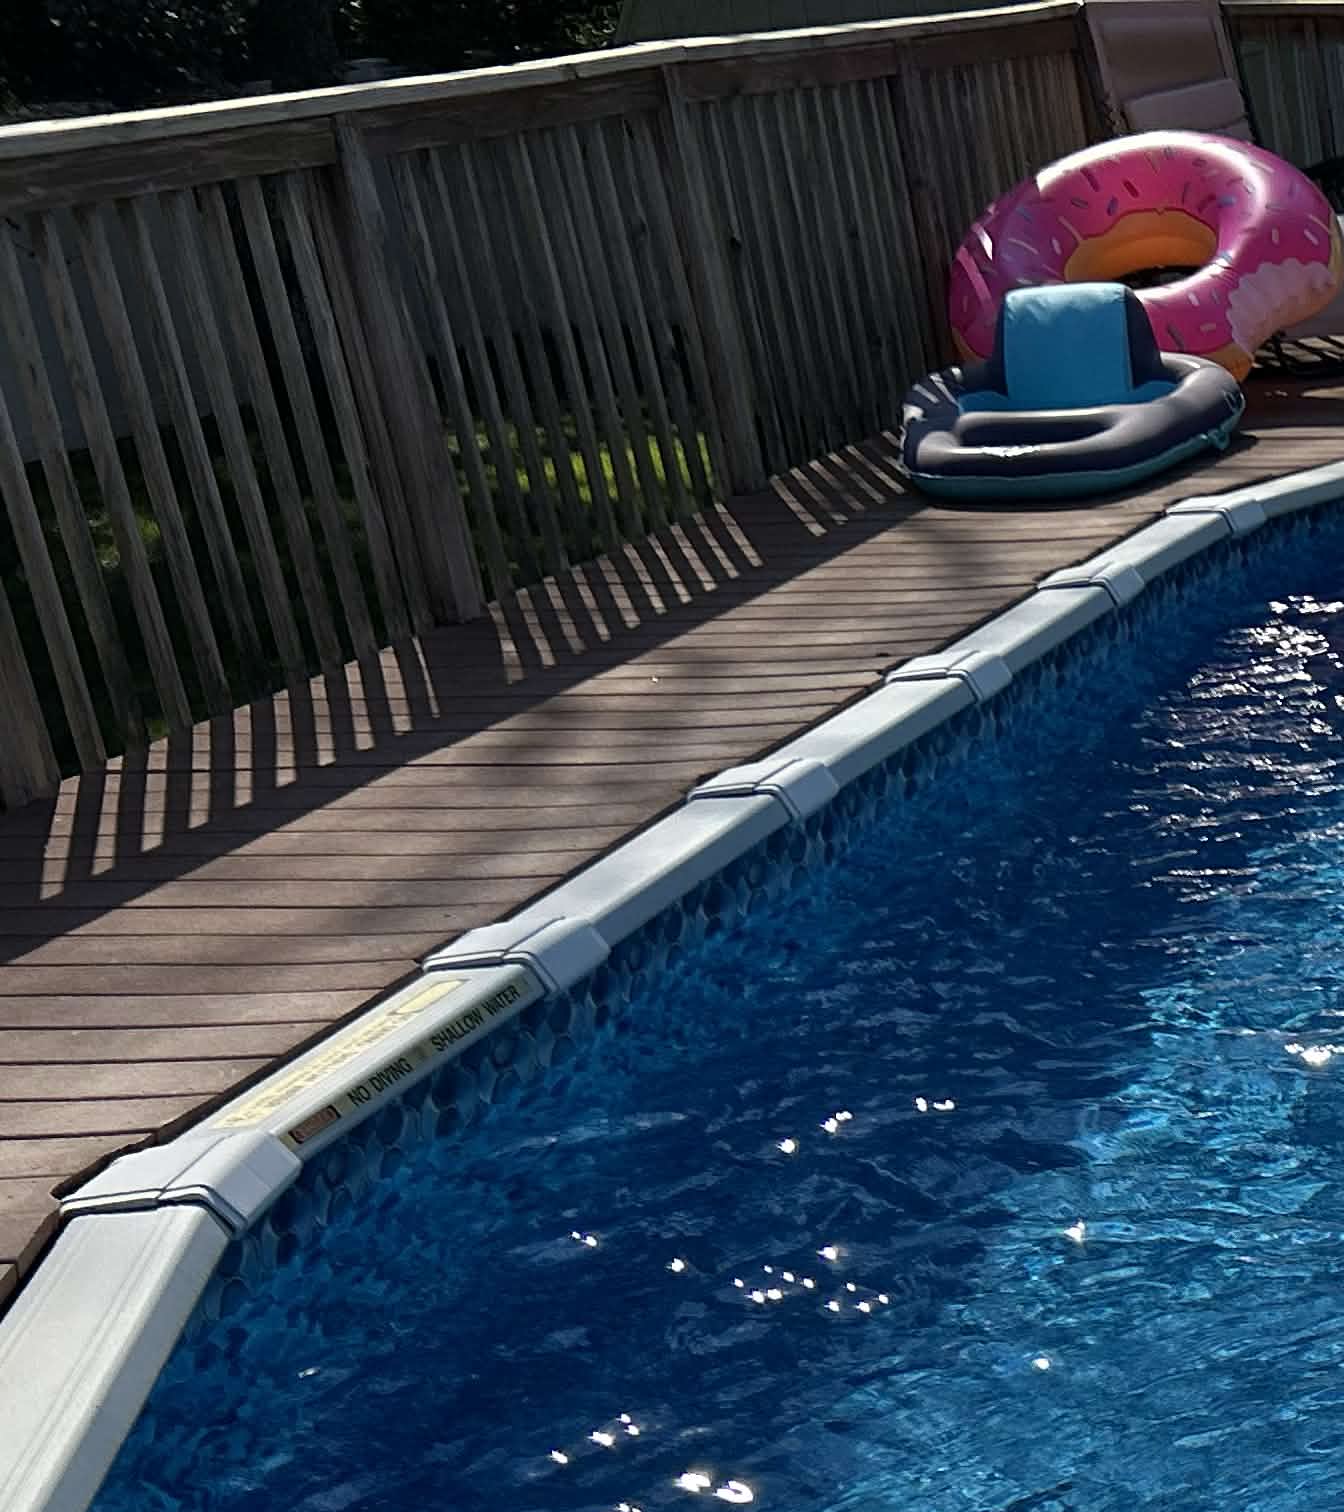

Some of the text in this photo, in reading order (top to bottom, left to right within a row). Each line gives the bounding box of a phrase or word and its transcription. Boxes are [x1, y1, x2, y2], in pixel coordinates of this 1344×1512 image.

[346, 1084, 372, 1107] NO
[368, 1057, 414, 1090] DIVING
[431, 1007, 486, 1052] SHALLOW
[480, 984, 521, 1017] WATER
